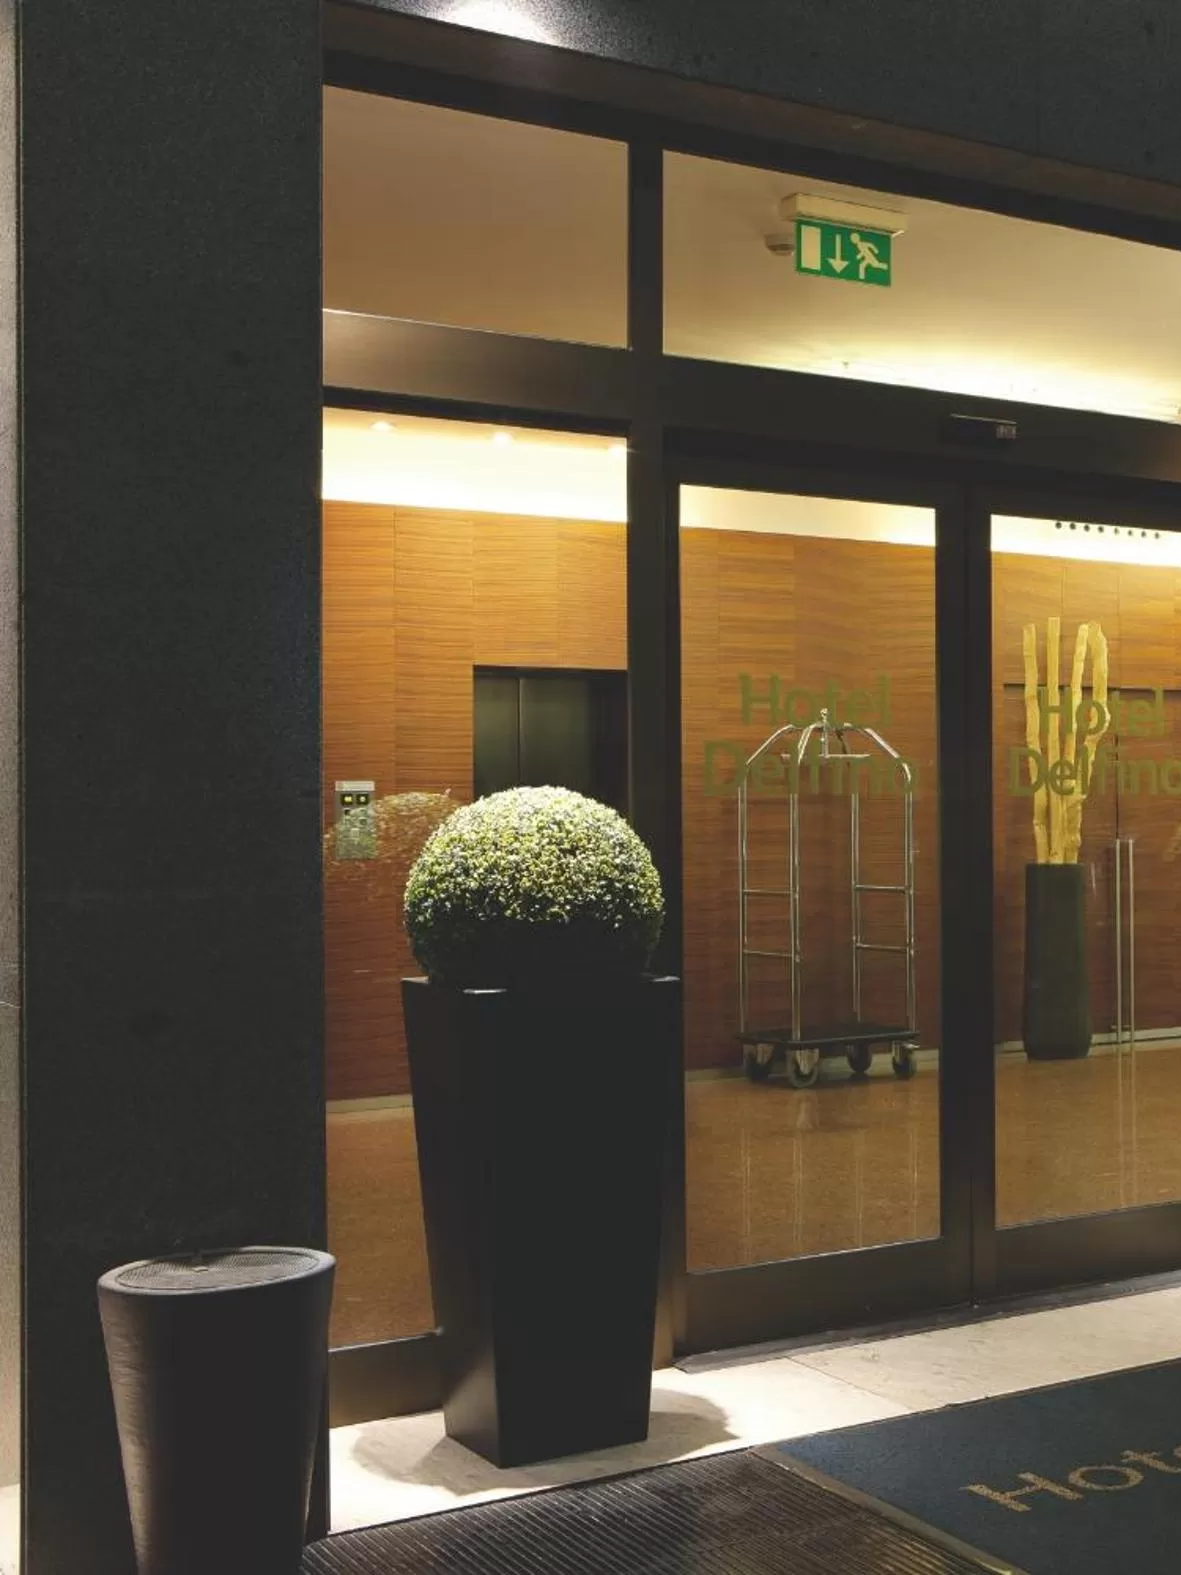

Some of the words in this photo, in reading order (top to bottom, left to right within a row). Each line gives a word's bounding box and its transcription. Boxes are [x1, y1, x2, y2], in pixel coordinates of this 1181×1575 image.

[738, 672, 892, 728] Hotel
[1036, 685, 1170, 738] Hotel
[704, 740, 920, 797] Delfino
